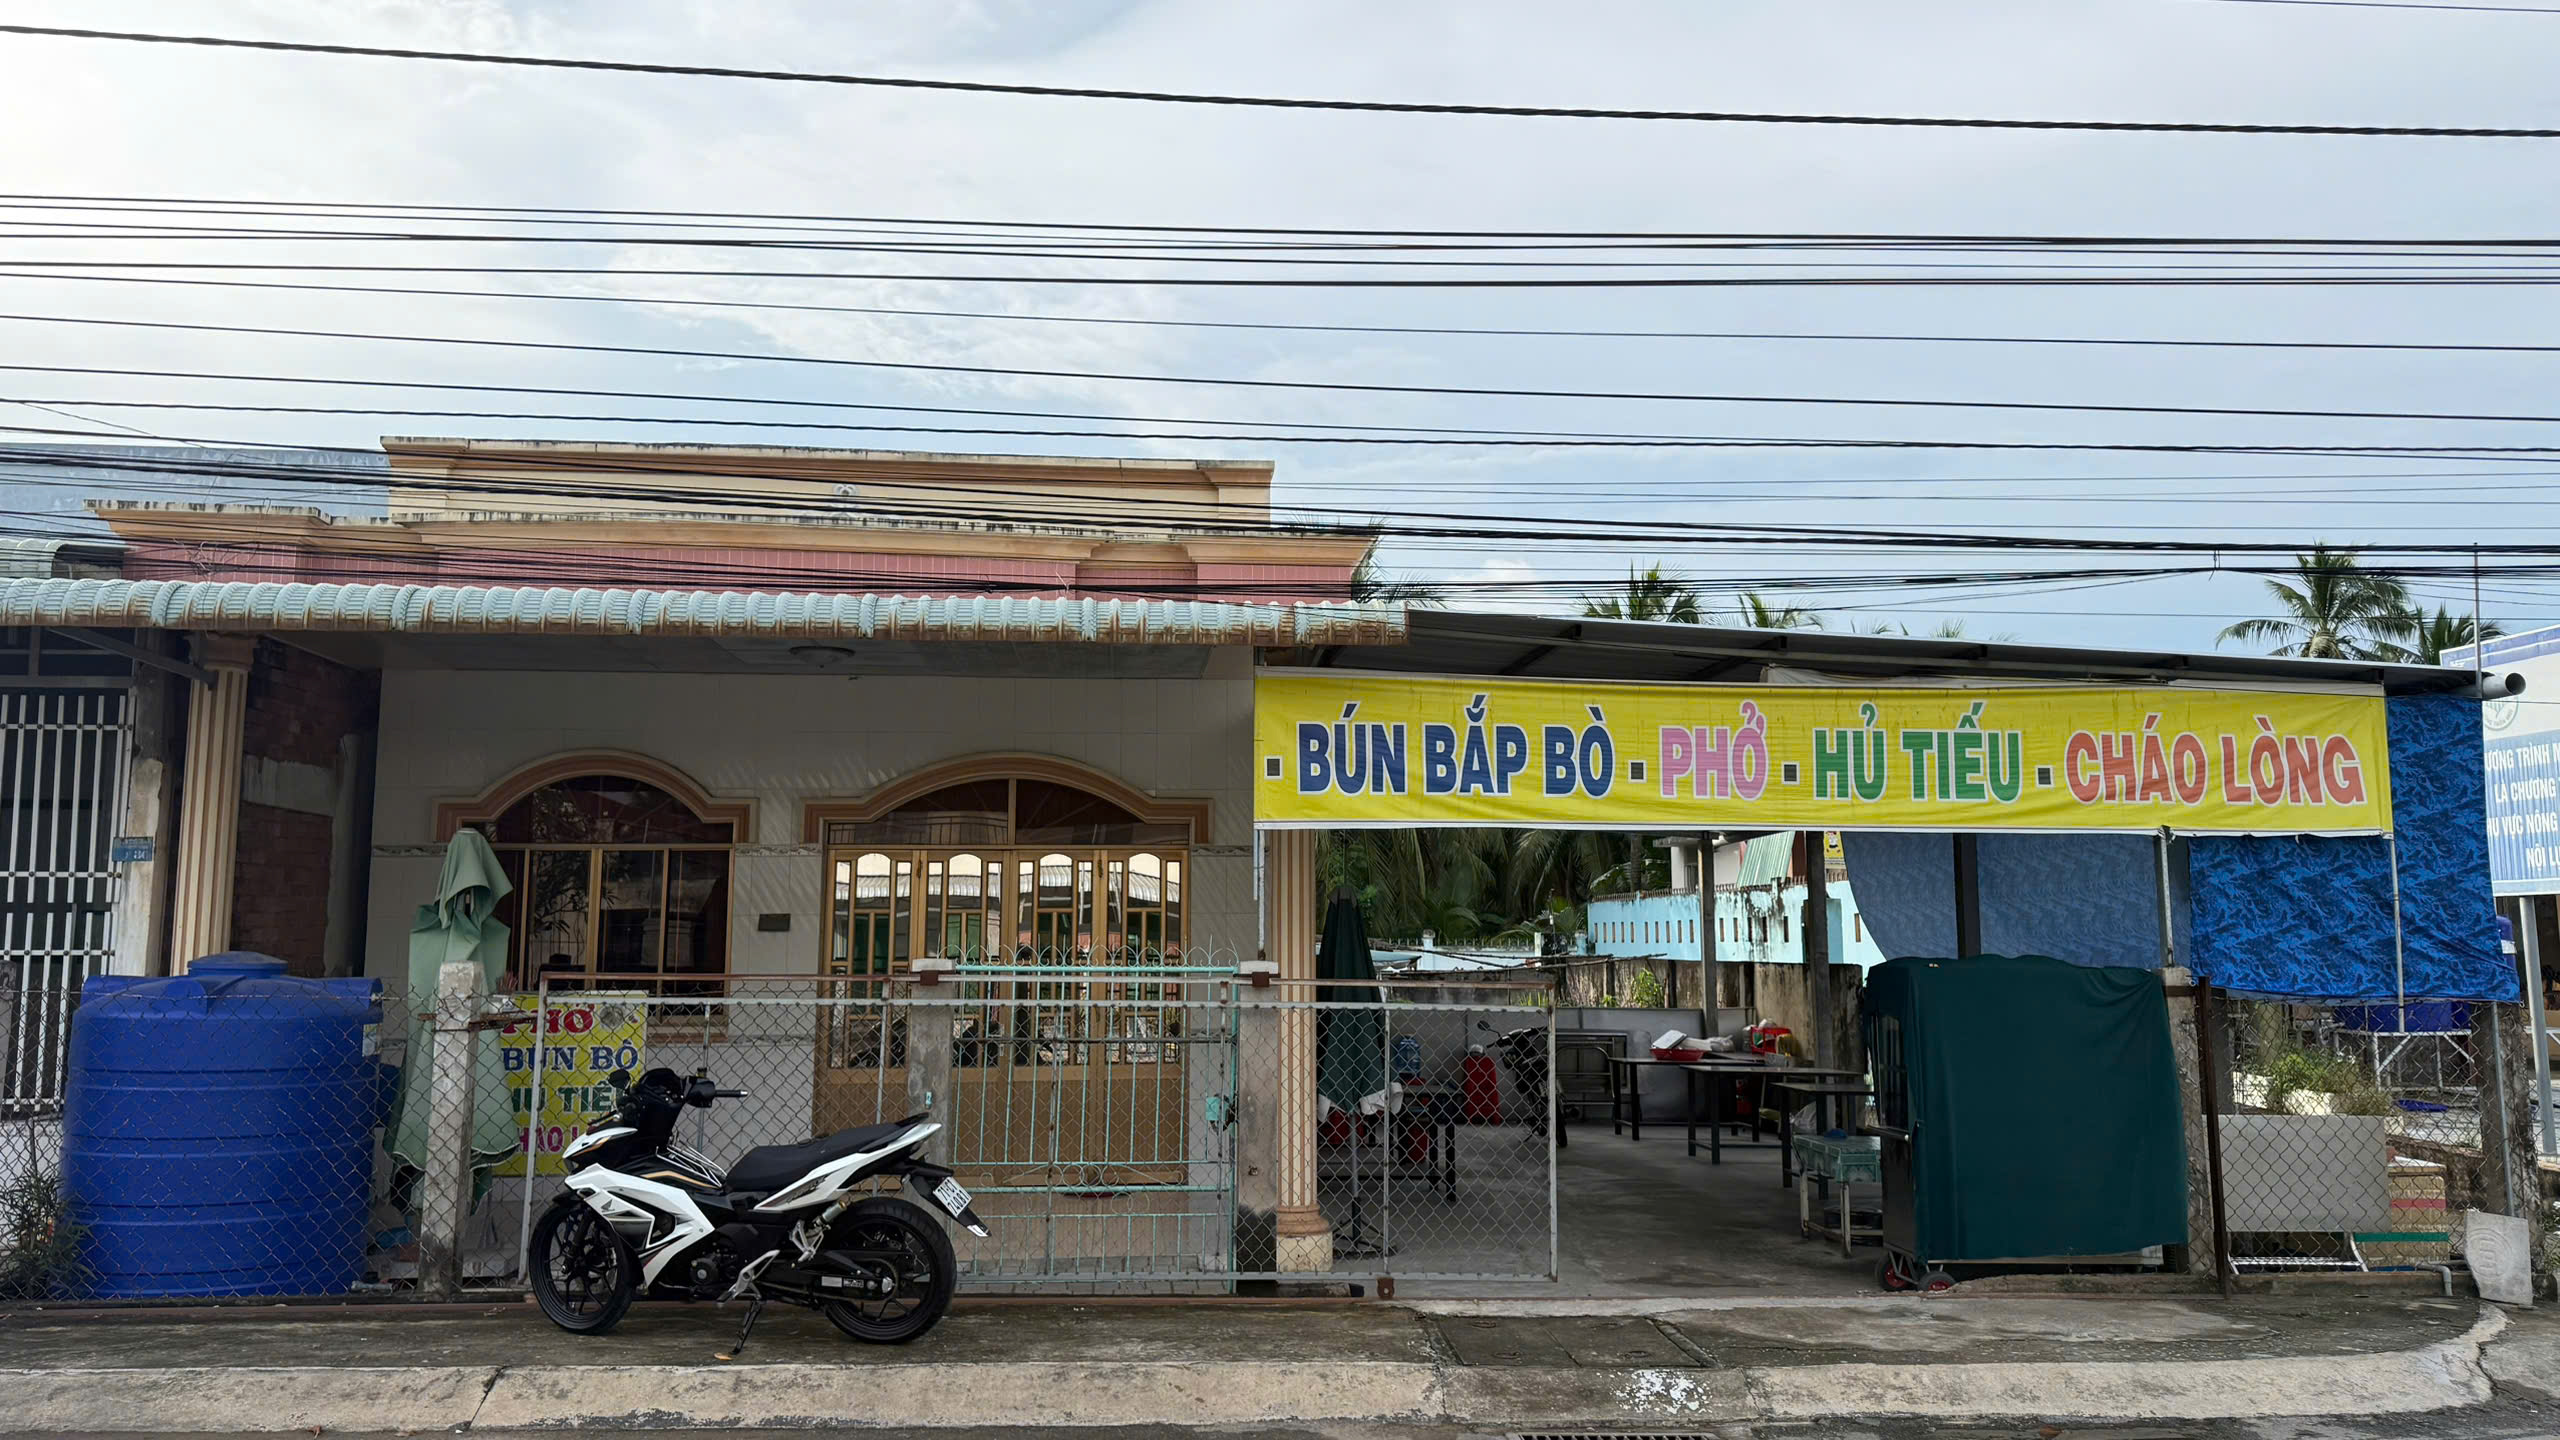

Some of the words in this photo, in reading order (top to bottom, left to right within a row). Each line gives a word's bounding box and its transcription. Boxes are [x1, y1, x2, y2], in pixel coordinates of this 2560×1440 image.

[1297, 701, 1407, 795] BÚN
[1422, 693, 1528, 797] BẮP
[1543, 704, 1615, 798] BÒ
[1659, 700, 1768, 799] PHỞ
[1813, 701, 1888, 801] HỦ
[1901, 700, 2022, 802] TIẾU
[2065, 713, 2208, 805] CHÁO
[2220, 714, 2367, 806] LÒNG
[2484, 749, 2514, 771] ƯƠNG
[2516, 742, 2550, 768] TRÌNH
[2494, 779, 2508, 803] LÀ
[2510, 777, 2556, 802] CHƯƠNG
[2501, 813, 2523, 840] VỰC
[2525, 809, 2558, 834] NÔNG
[2526, 843, 2546, 872] NỘI
